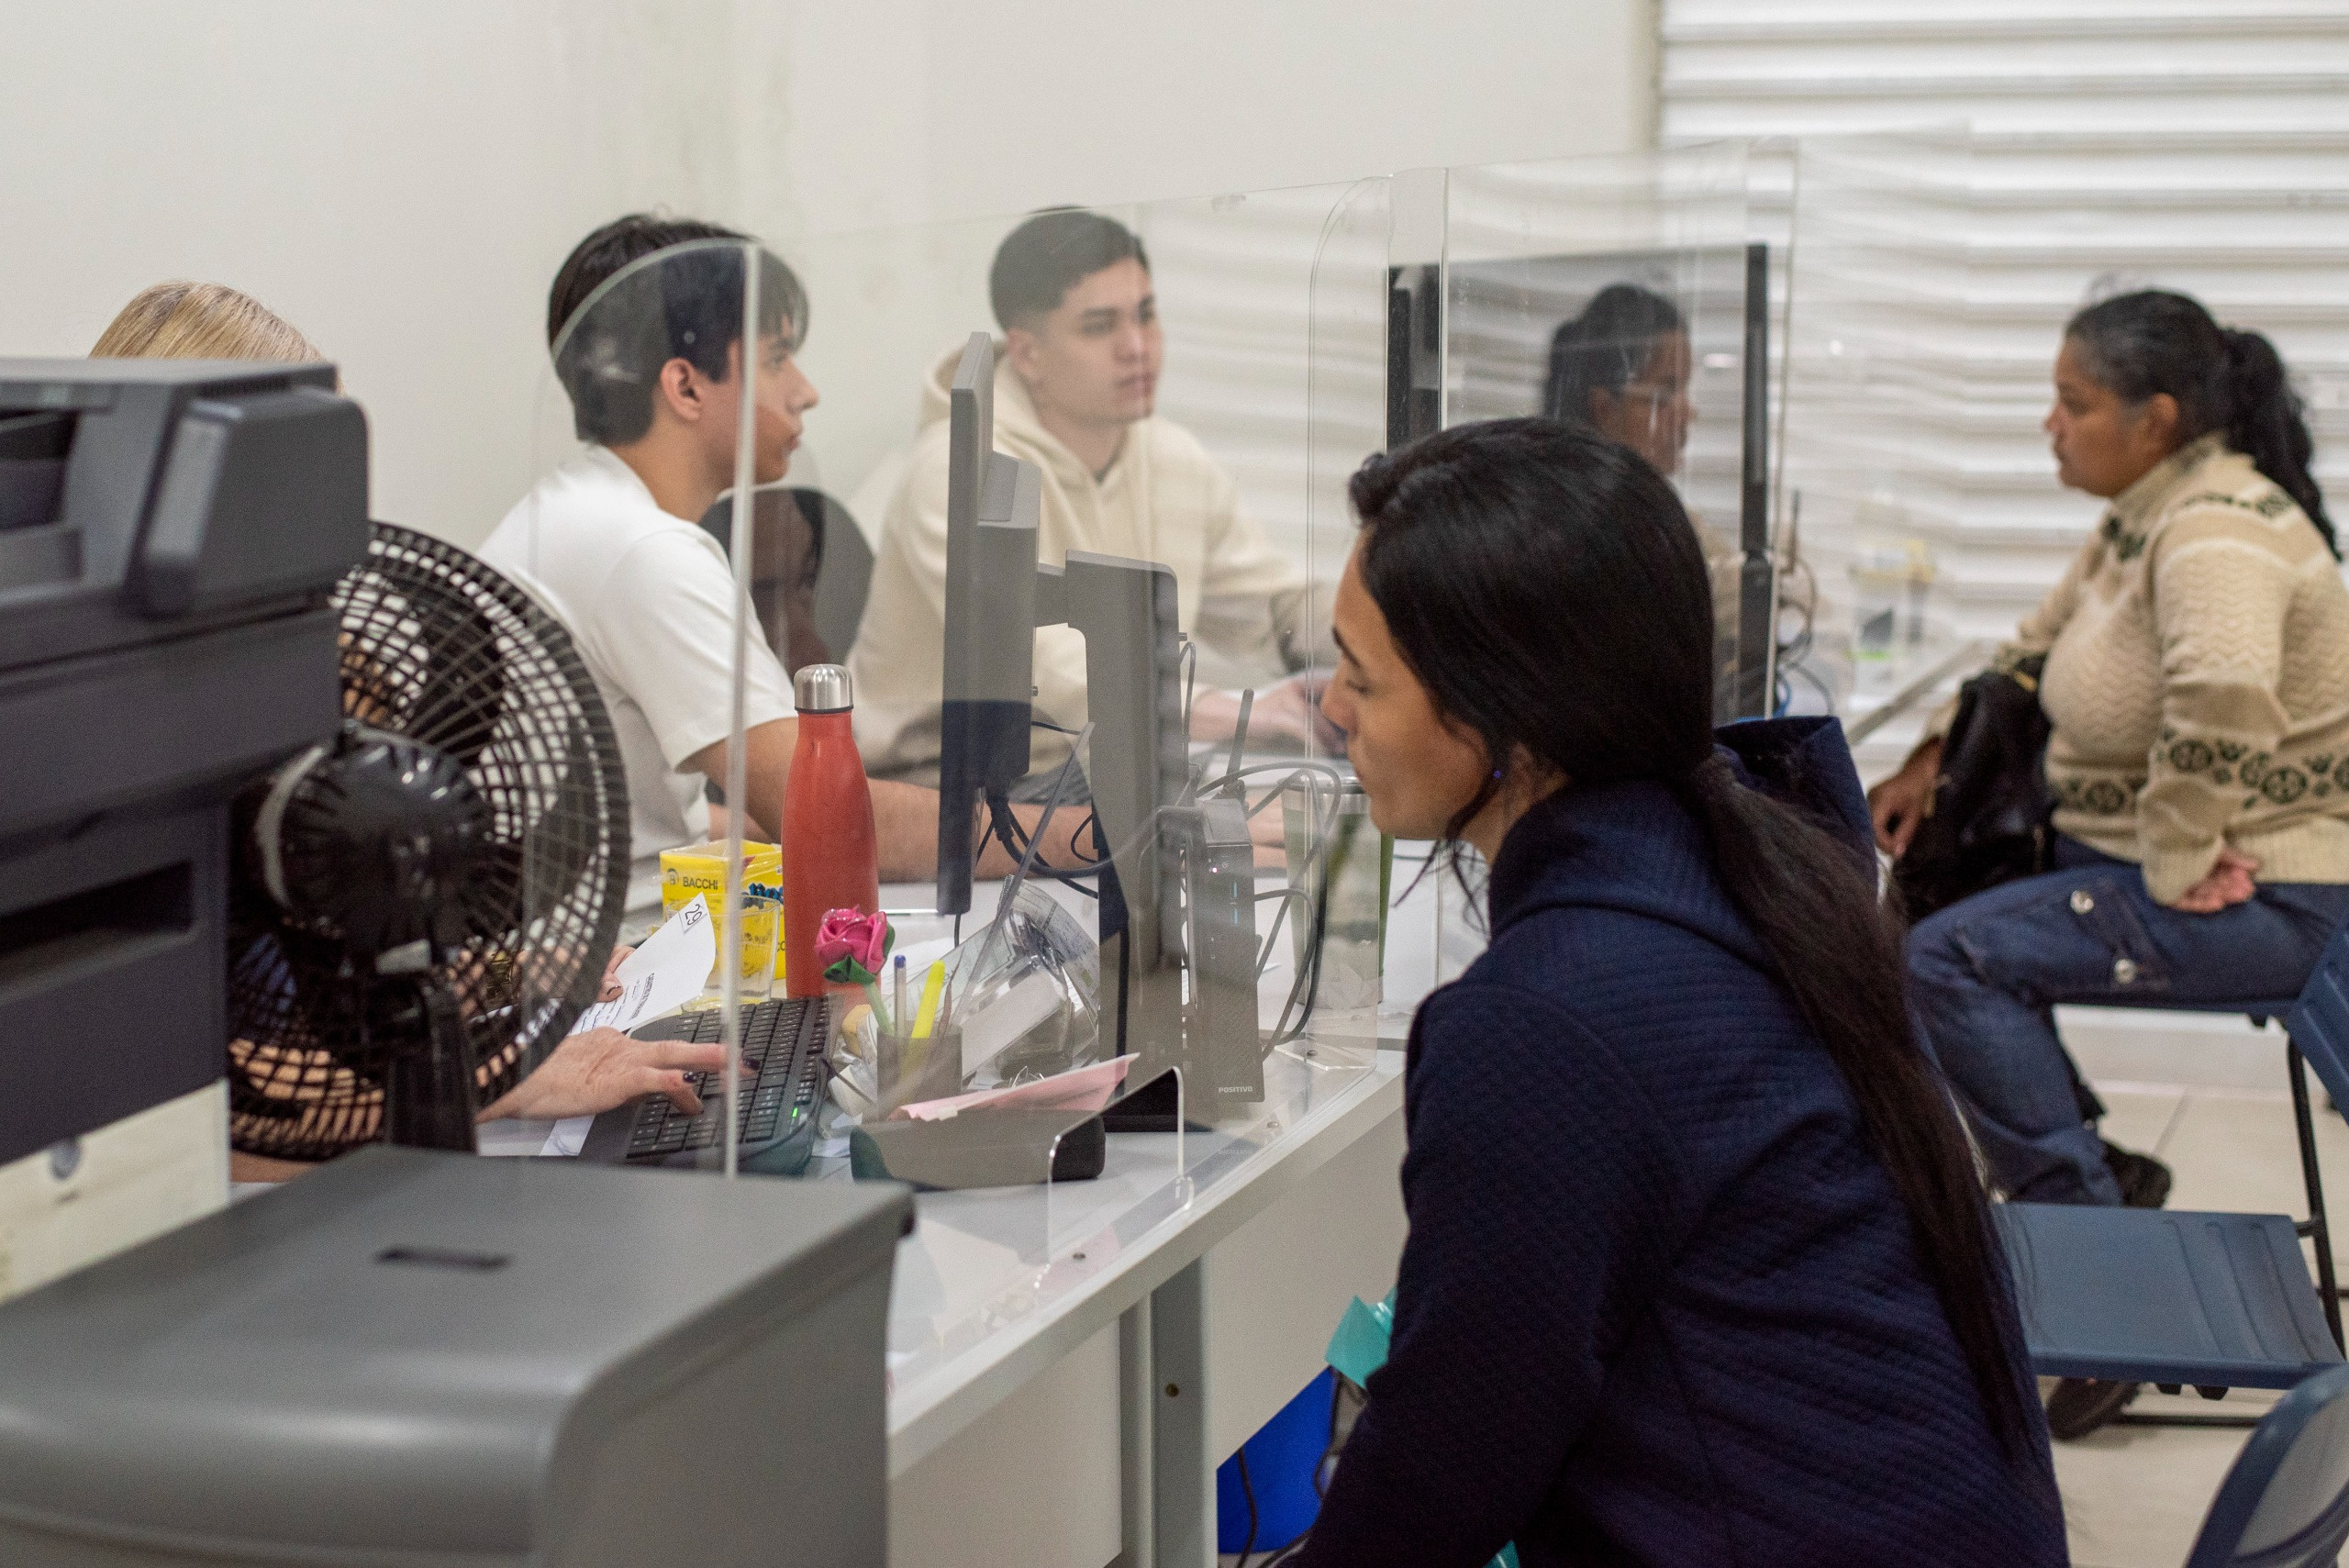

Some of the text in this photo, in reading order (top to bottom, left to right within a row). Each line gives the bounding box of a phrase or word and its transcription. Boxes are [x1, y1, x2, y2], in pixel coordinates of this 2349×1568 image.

[683, 876, 718, 890] BACCHI
[685, 904, 703, 926] 29
[1218, 1085, 1253, 1094] POSITIVO
